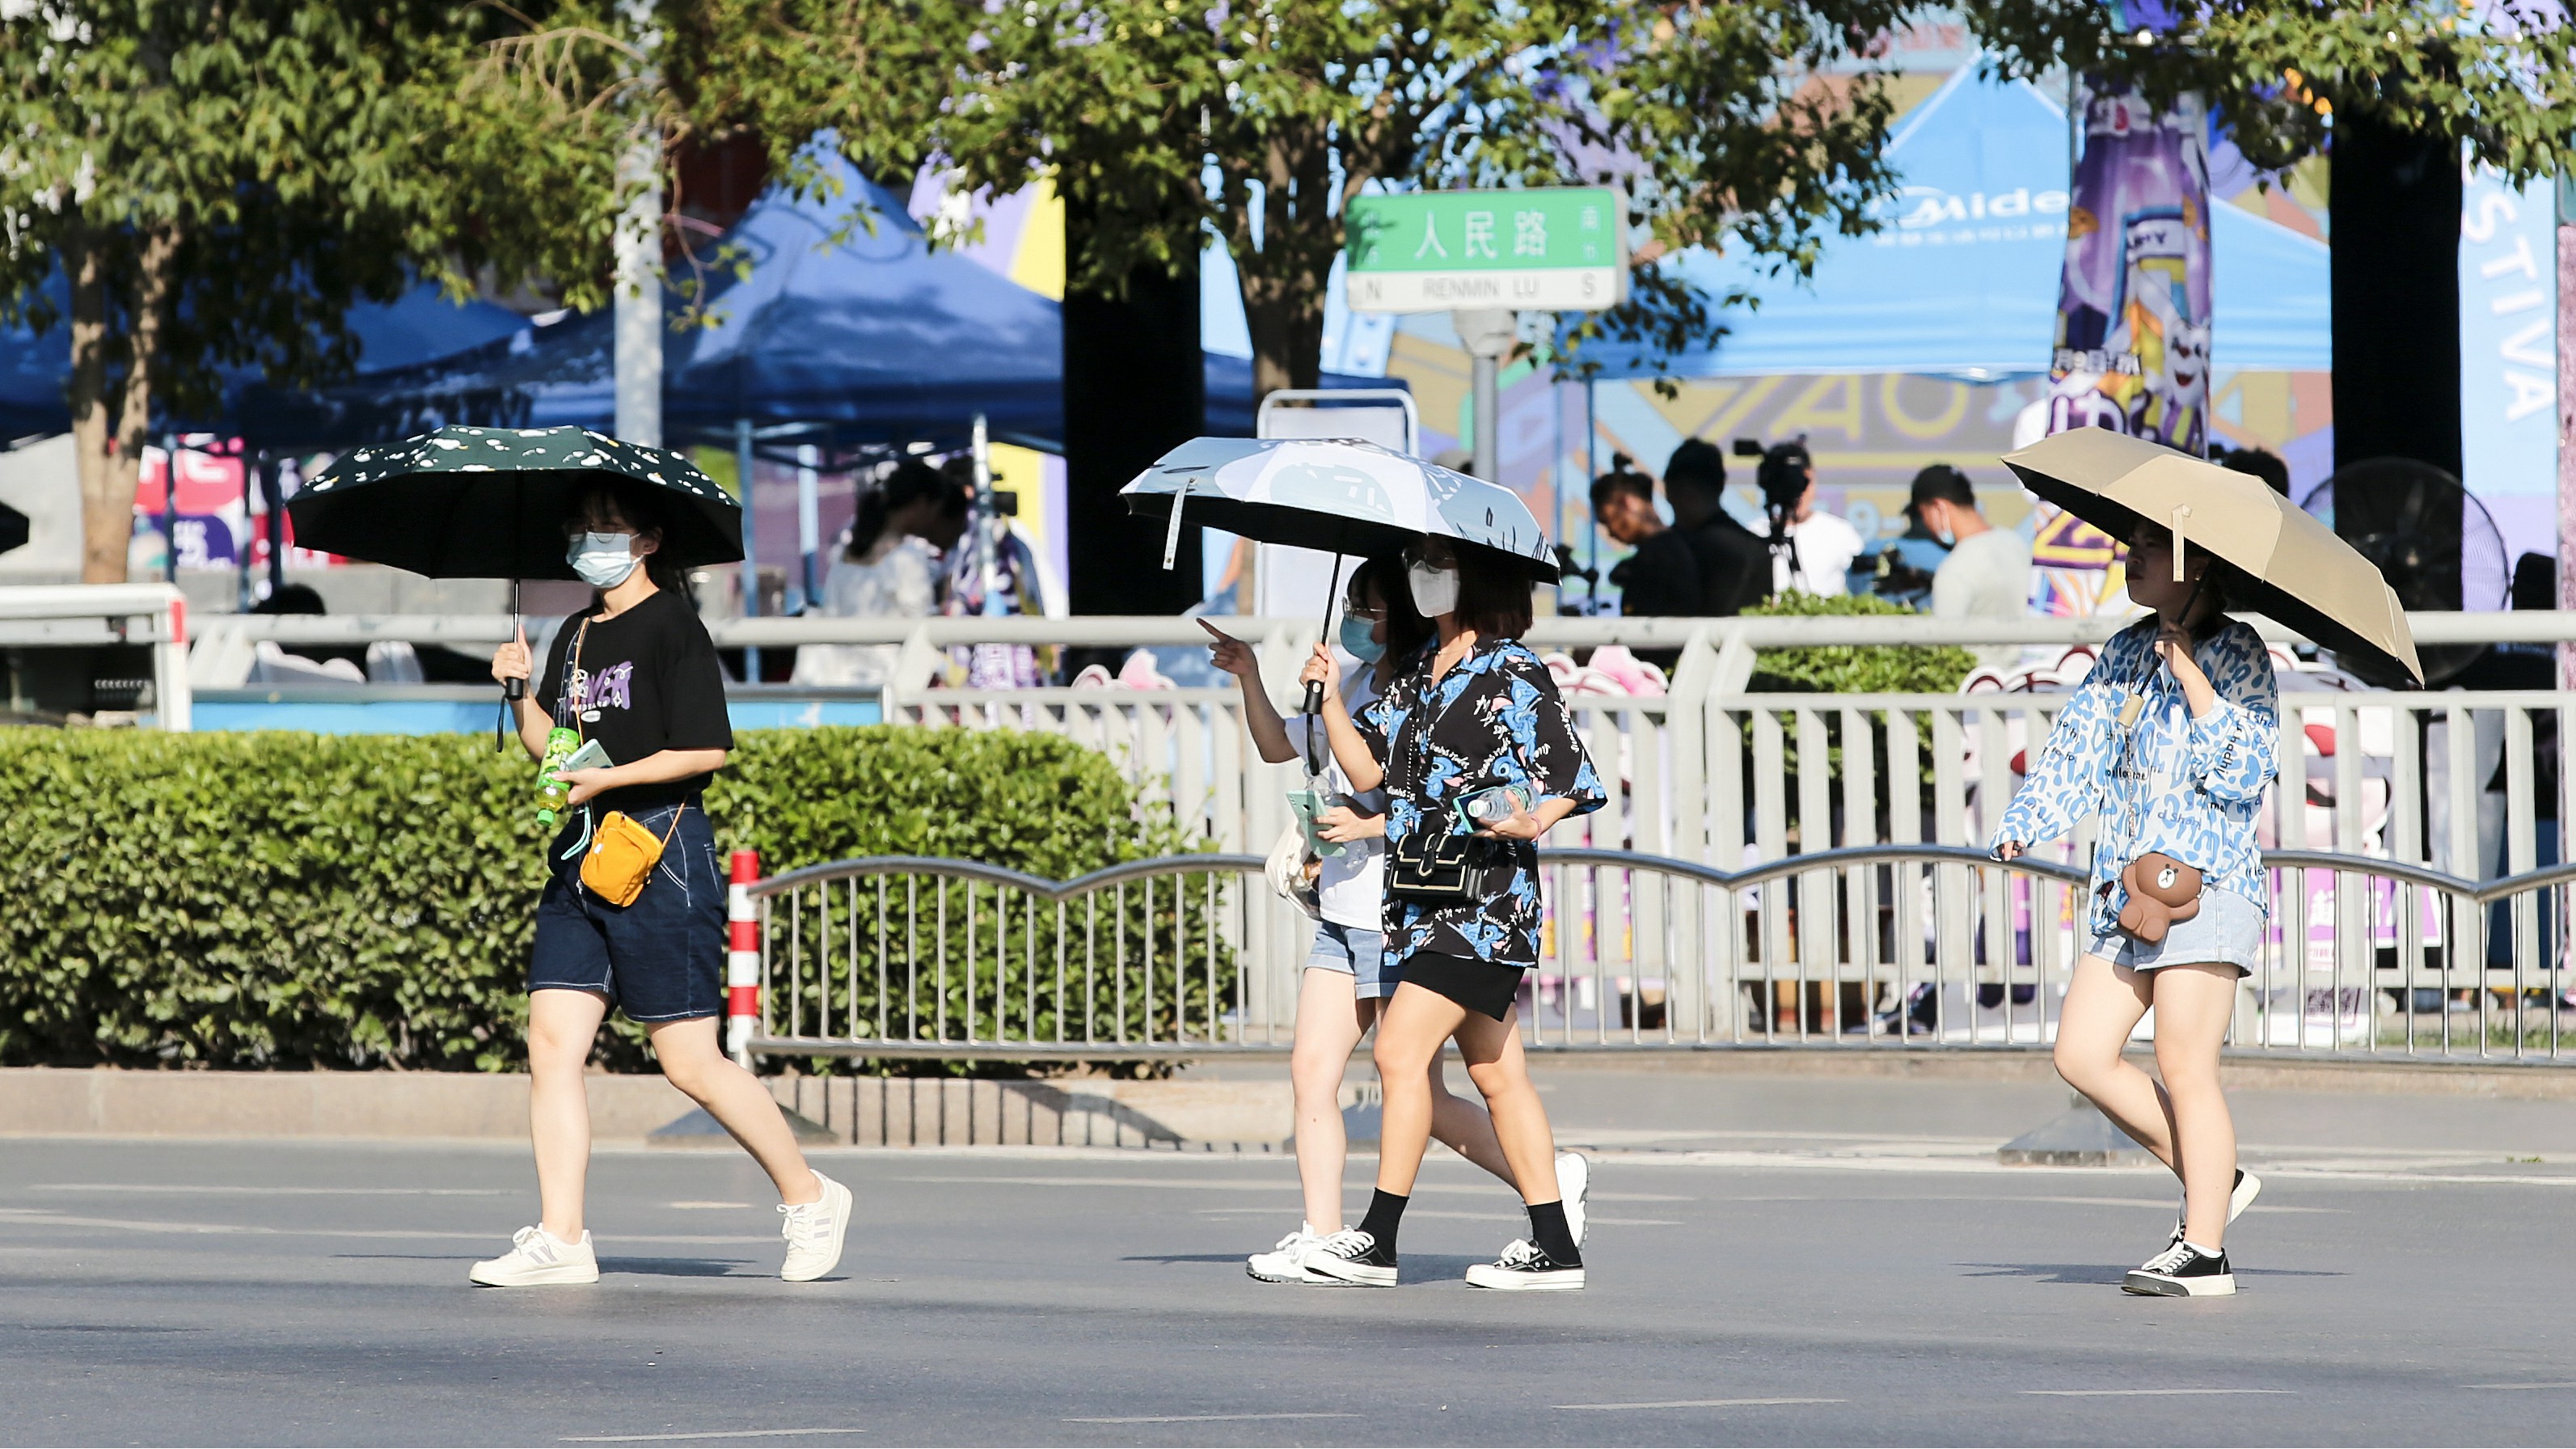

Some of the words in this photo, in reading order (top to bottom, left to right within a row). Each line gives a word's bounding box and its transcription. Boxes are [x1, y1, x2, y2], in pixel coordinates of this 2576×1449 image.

[1897, 185, 2070, 229] Mide
[1415, 210, 1548, 259] 人民路
[1366, 277, 1382, 299] N
[1422, 276, 1500, 299] RENMIN
[1513, 274, 1539, 297] LU
[1581, 272, 1597, 298] S
[2463, 154, 2557, 423] STIVA
